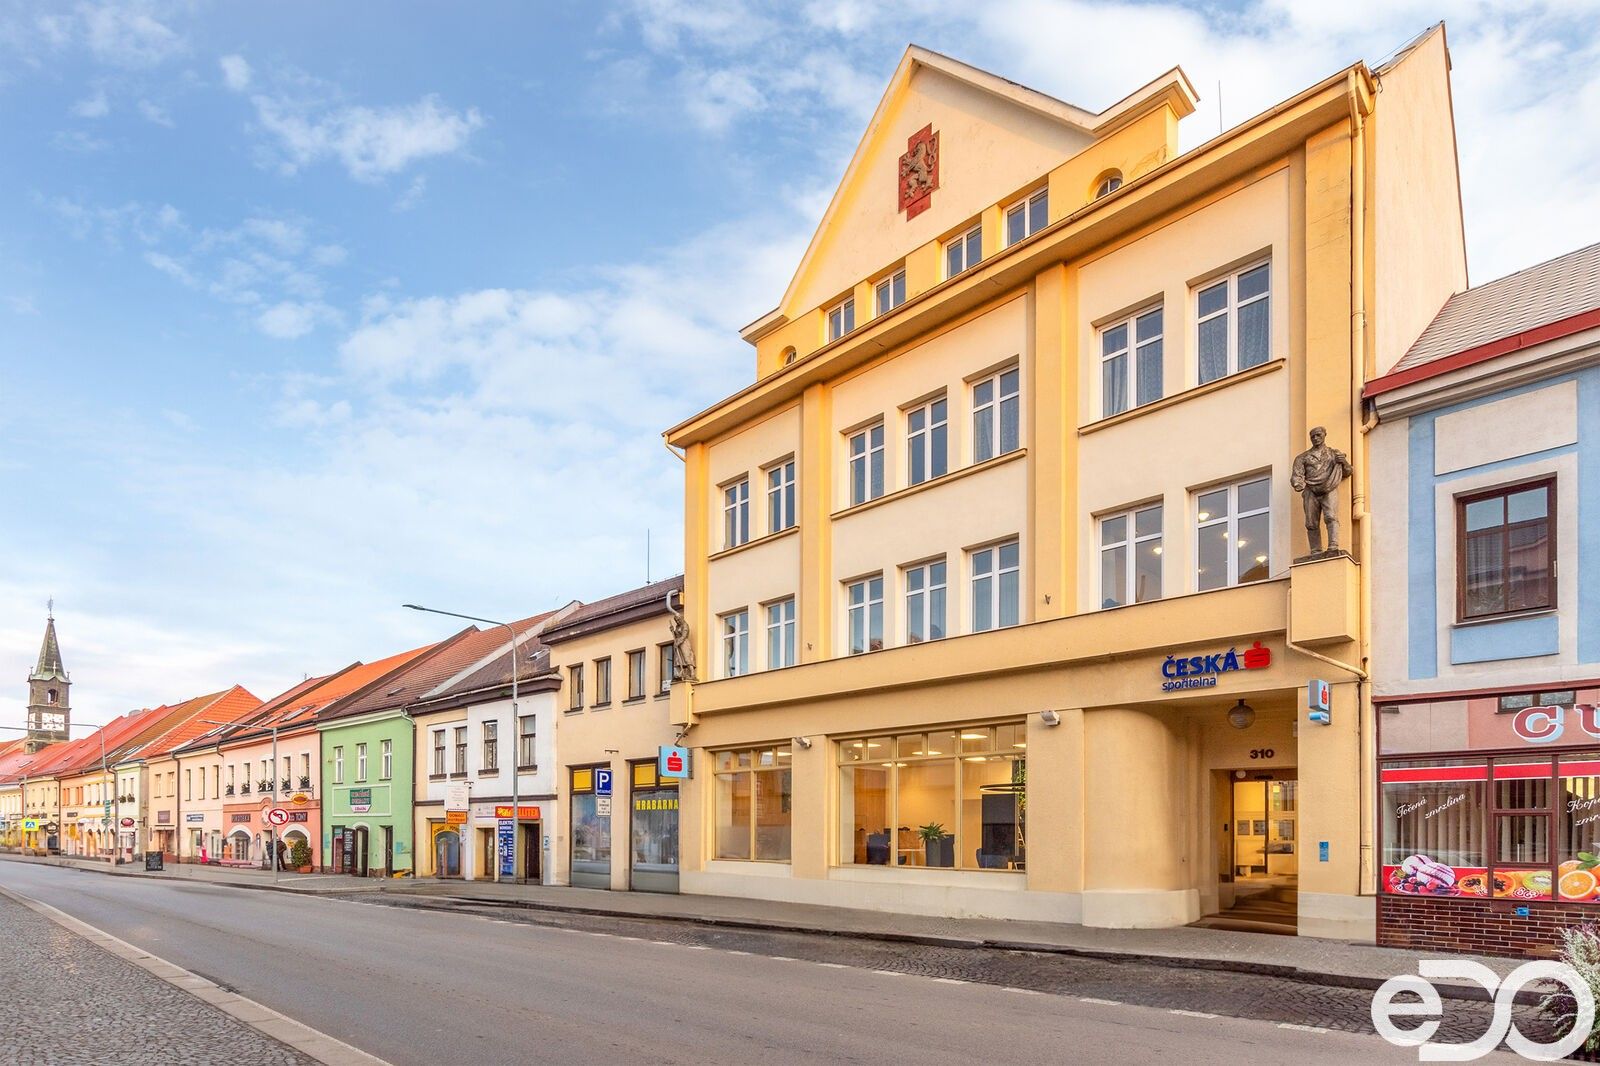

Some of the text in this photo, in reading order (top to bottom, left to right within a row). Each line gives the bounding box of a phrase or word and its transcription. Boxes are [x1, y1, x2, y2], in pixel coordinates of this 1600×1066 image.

[1162, 647, 1239, 678] ČESKÁ
[1162, 676, 1217, 691] spořitelna
[1250, 749, 1275, 759] 310
[599, 772, 610, 788] P
[1425, 793, 1466, 819] zmrzlina
[1575, 814, 1600, 826] zmr
